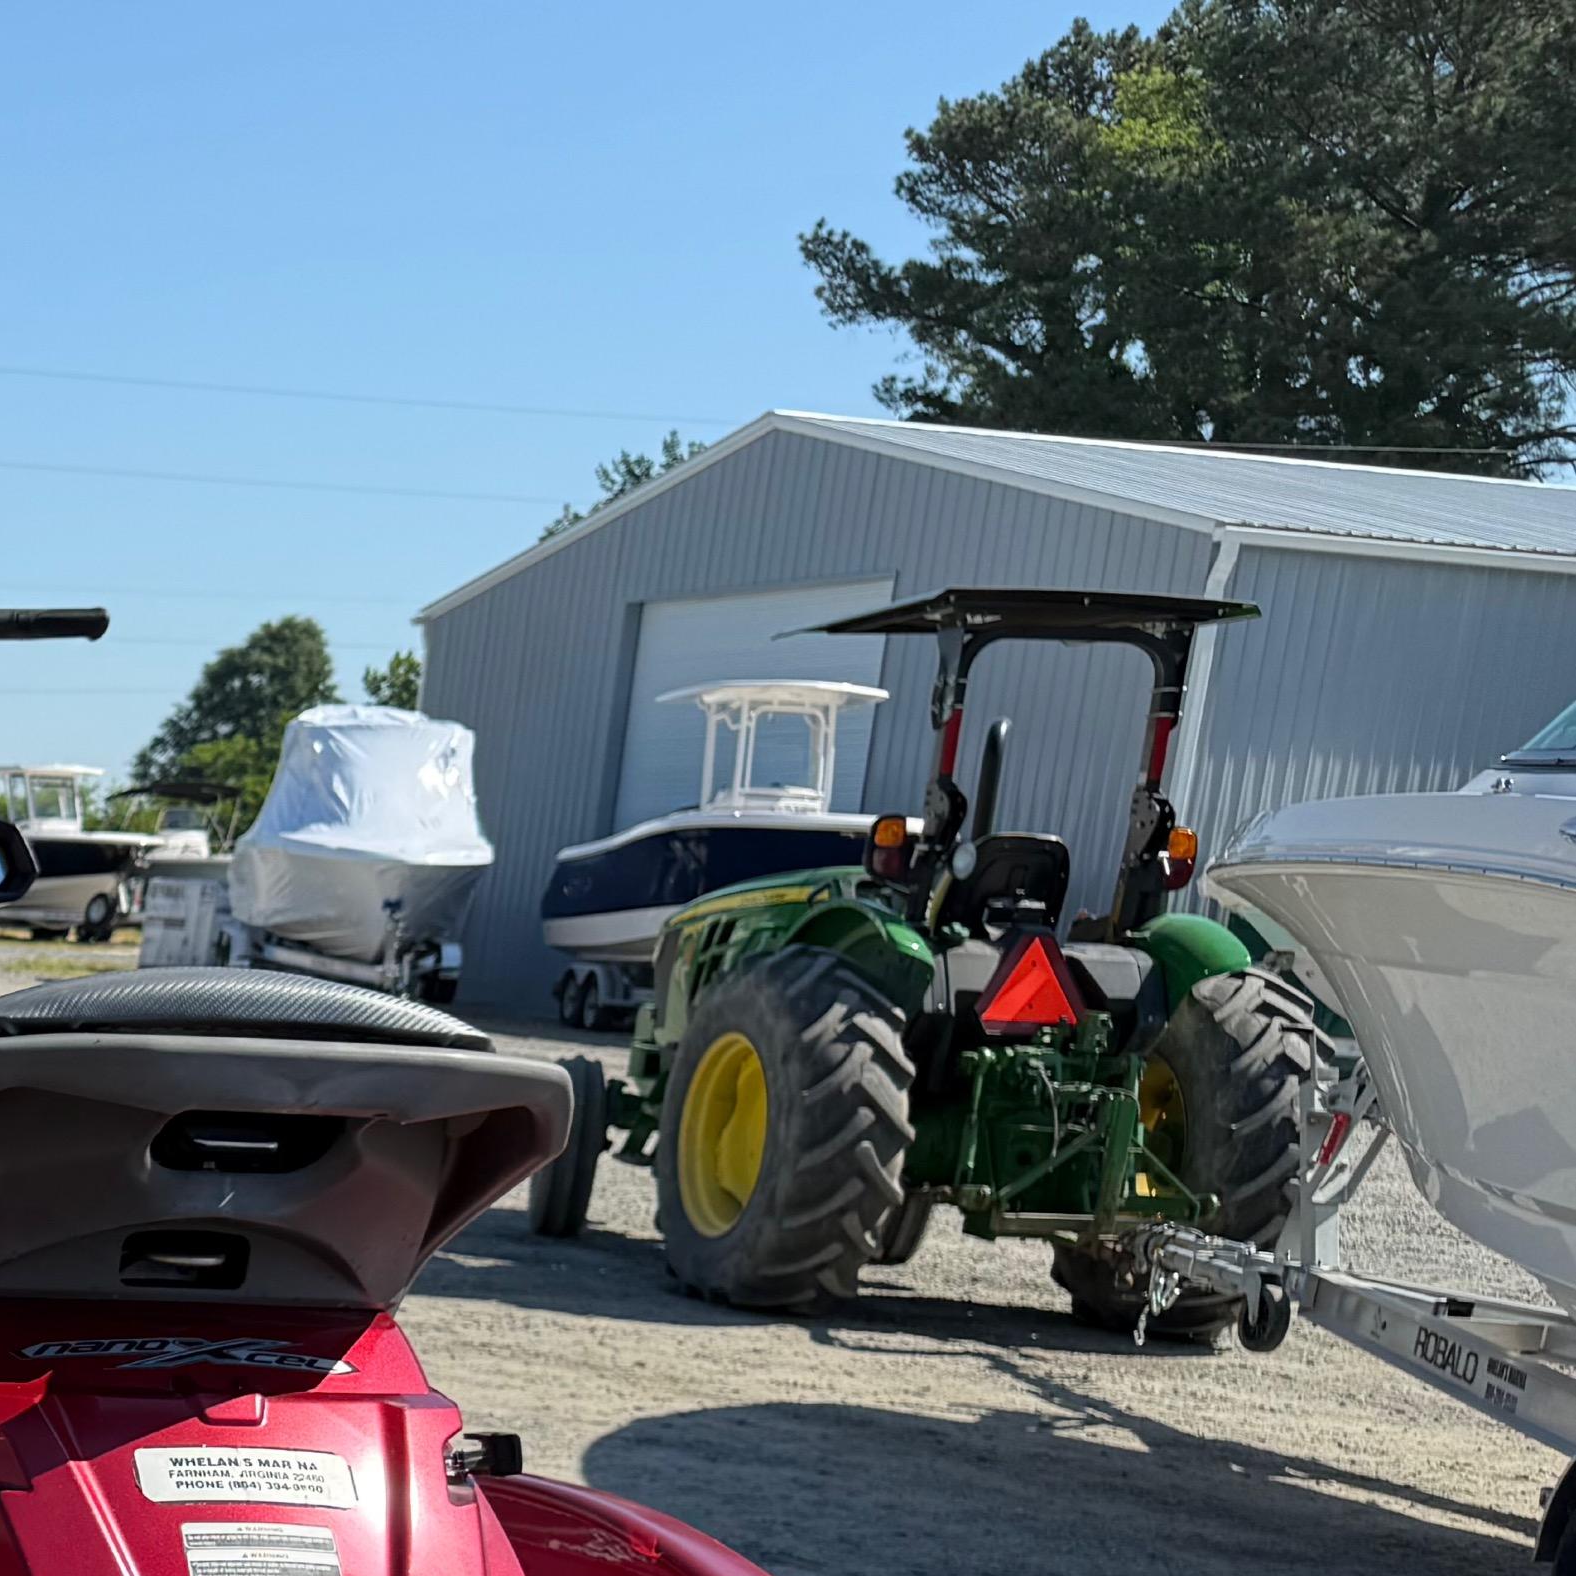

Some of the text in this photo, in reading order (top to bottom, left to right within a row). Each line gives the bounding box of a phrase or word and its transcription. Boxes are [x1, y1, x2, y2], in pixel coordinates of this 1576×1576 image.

[1413, 1325, 1479, 1385] ROBALO
[258, 1459, 318, 1471] MARNA
[175, 1480, 225, 1490] PHONE
